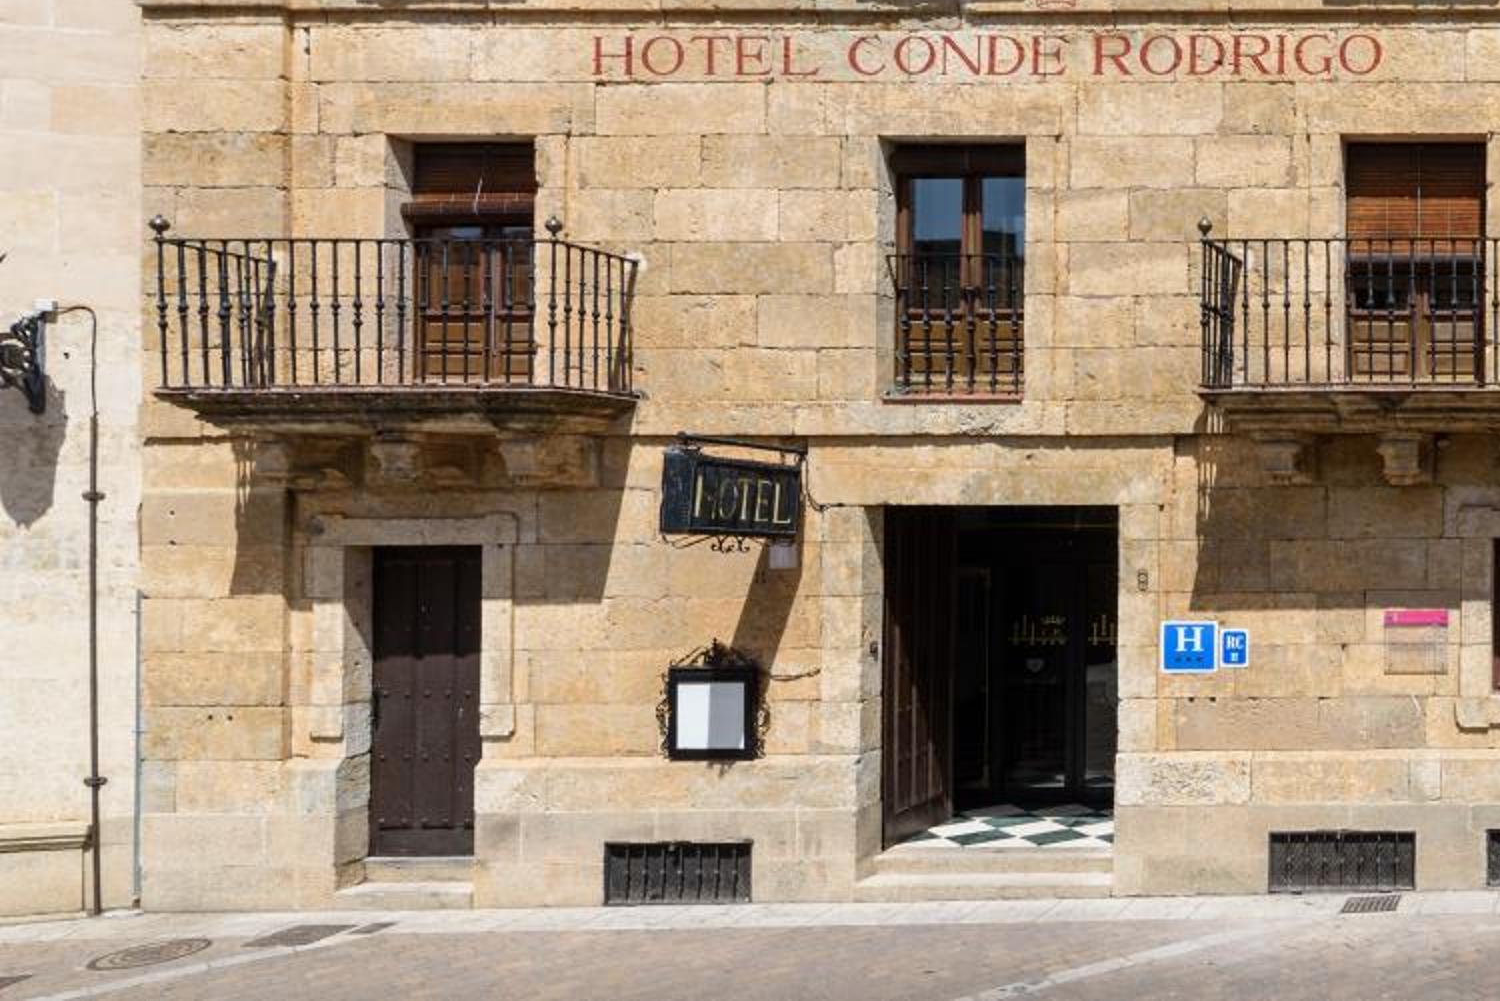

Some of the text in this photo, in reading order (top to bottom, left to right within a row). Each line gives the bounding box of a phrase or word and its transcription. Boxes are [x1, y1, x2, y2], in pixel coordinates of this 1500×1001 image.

[591, 34, 1383, 77] HOTEL CONDE RODRIGO
[692, 473, 792, 525] HOTEL
[1174, 626, 1206, 652] H
